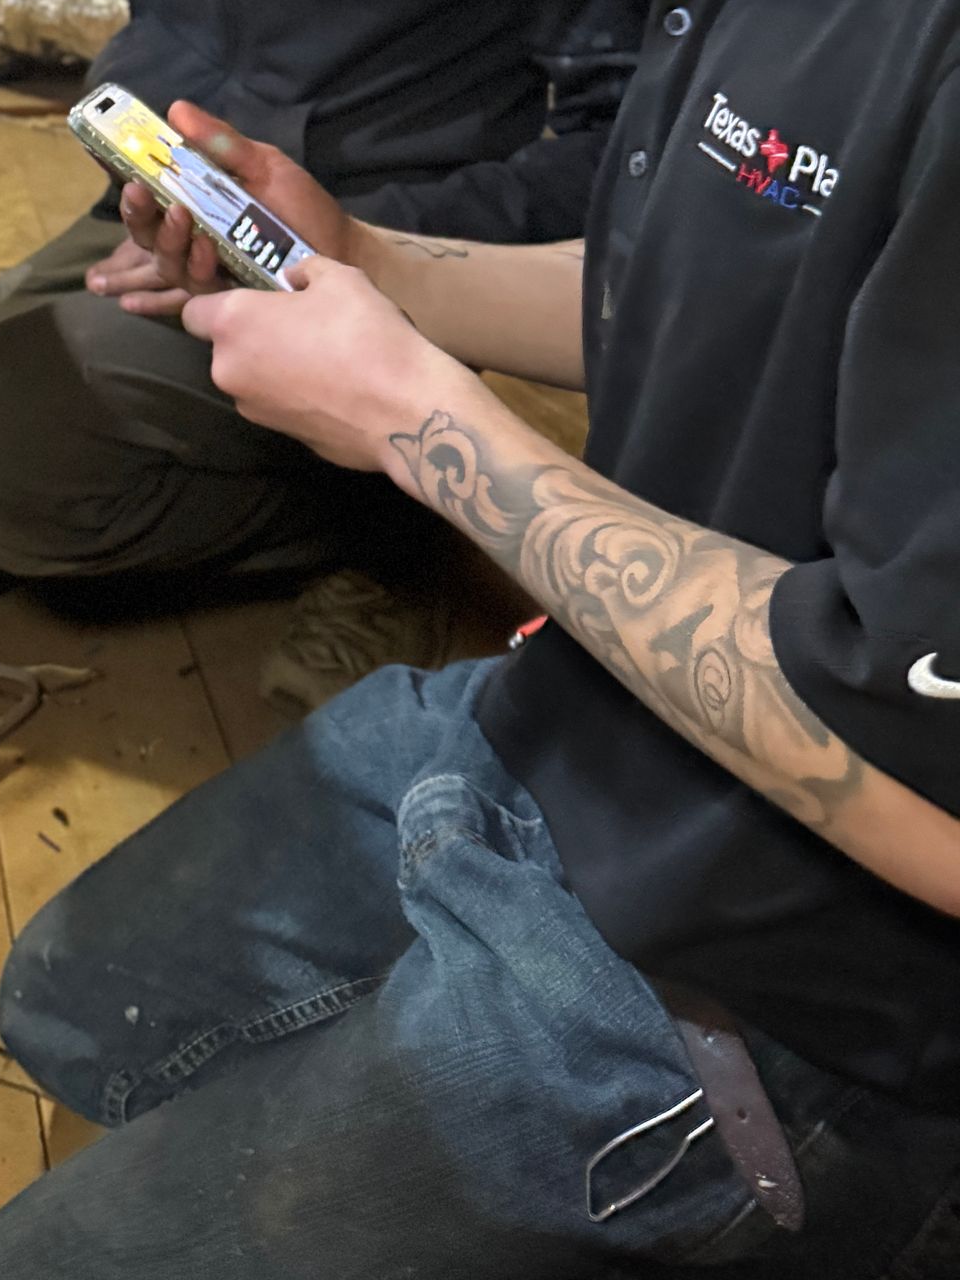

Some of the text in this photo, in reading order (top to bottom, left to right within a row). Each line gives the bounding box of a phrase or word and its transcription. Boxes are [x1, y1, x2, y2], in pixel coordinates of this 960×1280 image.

[704, 92, 840, 198] Texas Pla
[736, 163, 800, 209] HVAC
